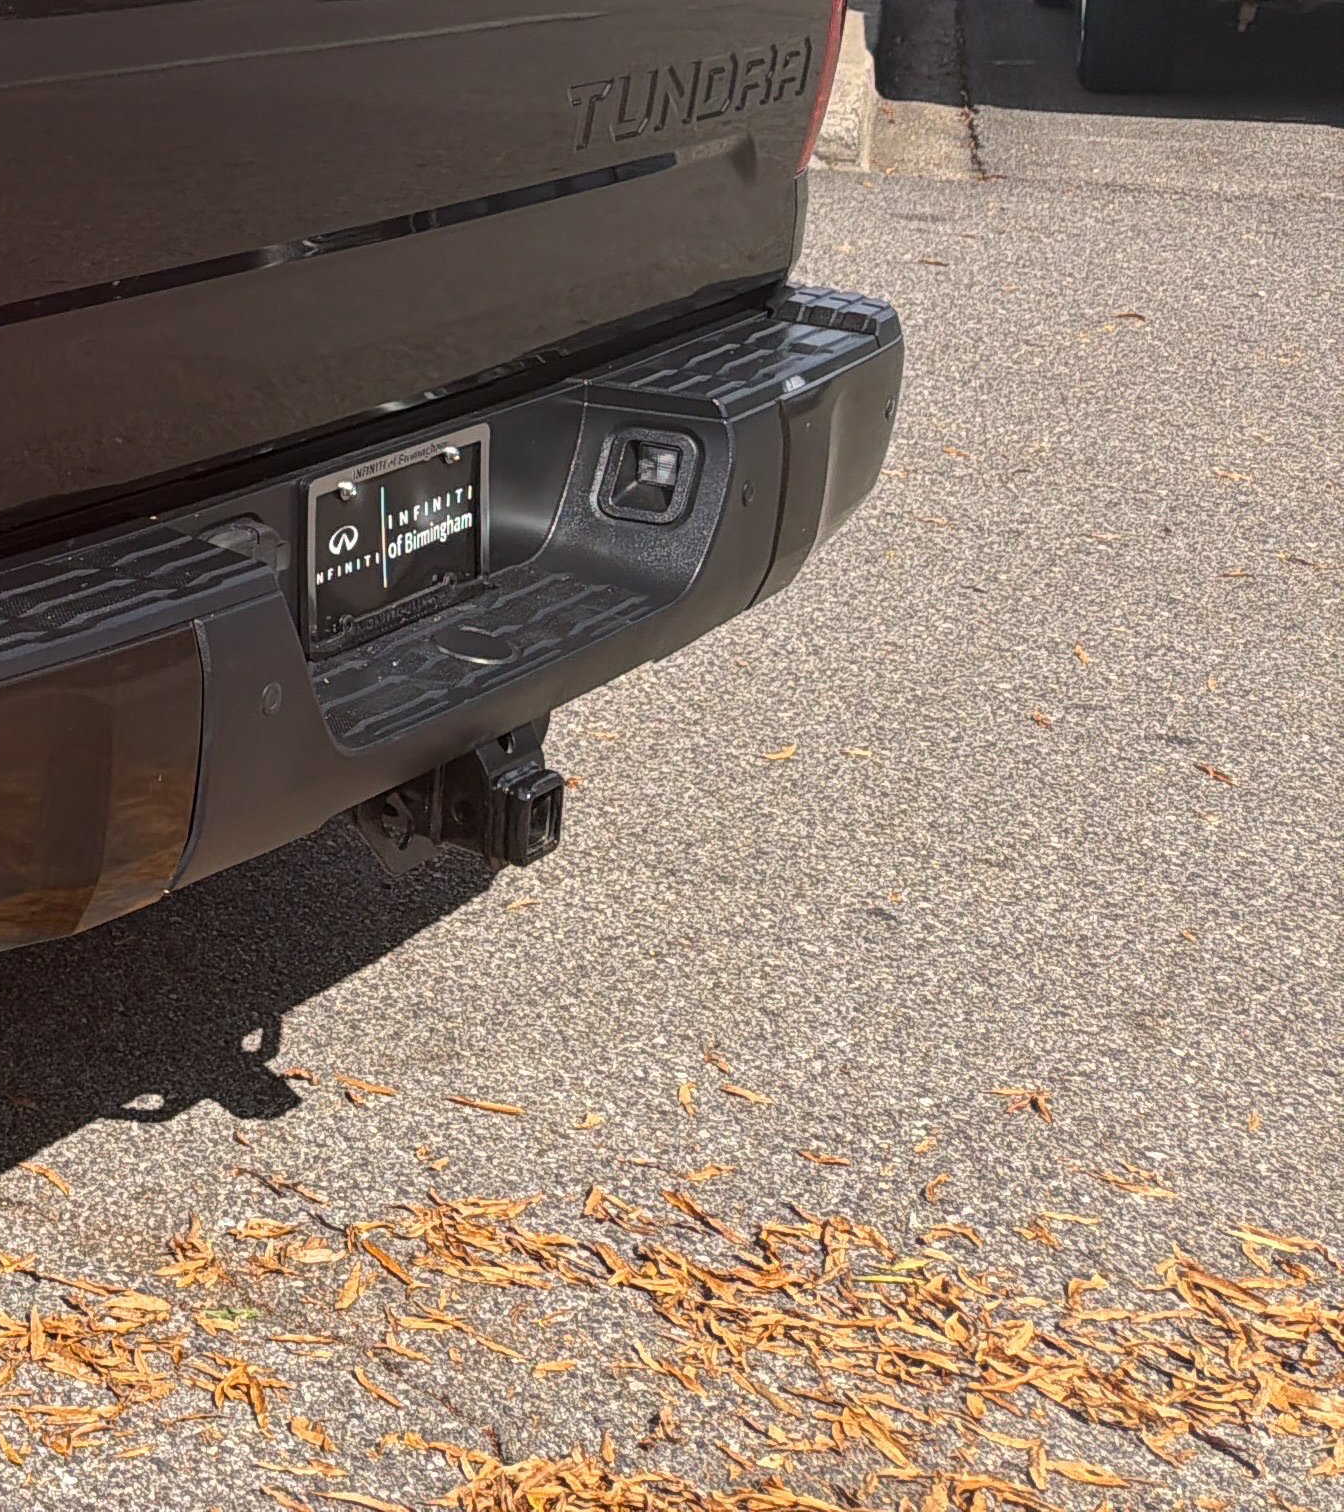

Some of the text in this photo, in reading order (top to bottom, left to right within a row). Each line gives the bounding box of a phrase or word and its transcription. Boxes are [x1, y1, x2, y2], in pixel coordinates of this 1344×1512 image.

[567, 35, 813, 151] TUNDRA
[388, 485, 473, 530] INFINITI
[388, 512, 473, 559] of Birmingham
[316, 552, 381, 586] NFINITI
